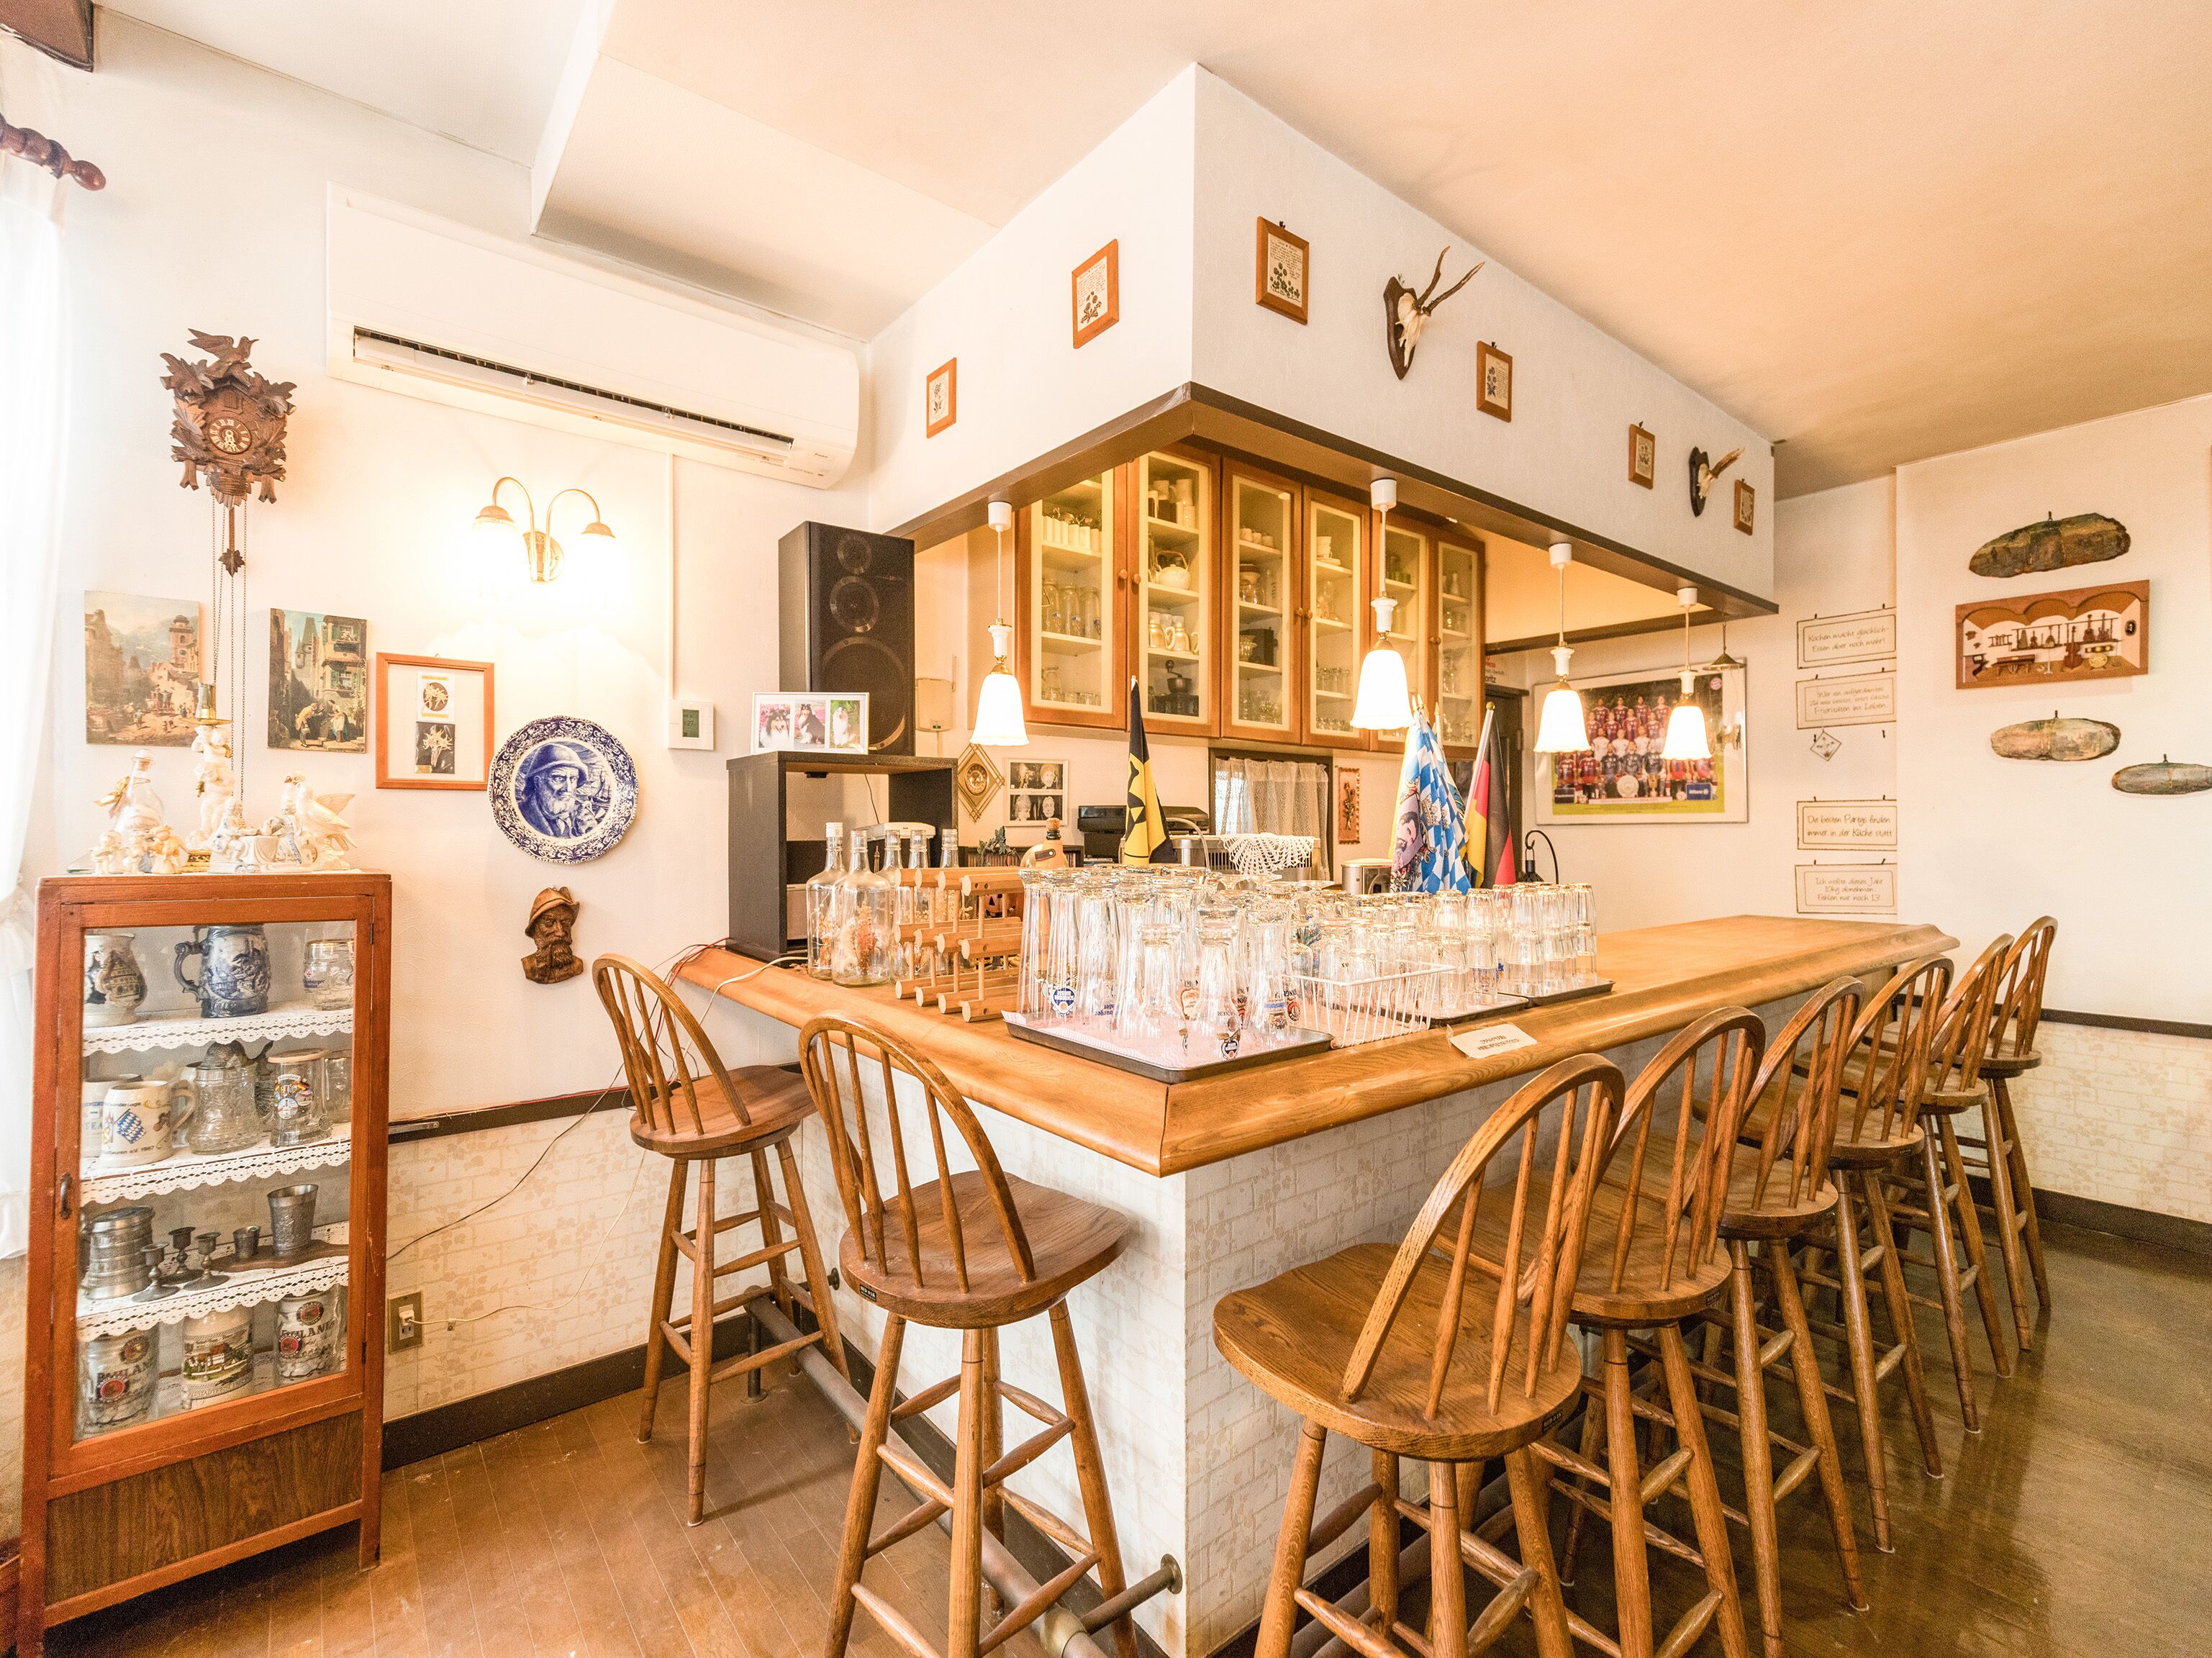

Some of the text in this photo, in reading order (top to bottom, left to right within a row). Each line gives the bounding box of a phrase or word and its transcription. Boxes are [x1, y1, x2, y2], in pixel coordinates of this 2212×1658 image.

[1808, 633, 1831, 642] Kochen
[1833, 630, 1854, 640] macht
[1808, 815, 1818, 824] Die
[1821, 815, 1842, 823] besten
[1869, 815, 1890, 823] finden
